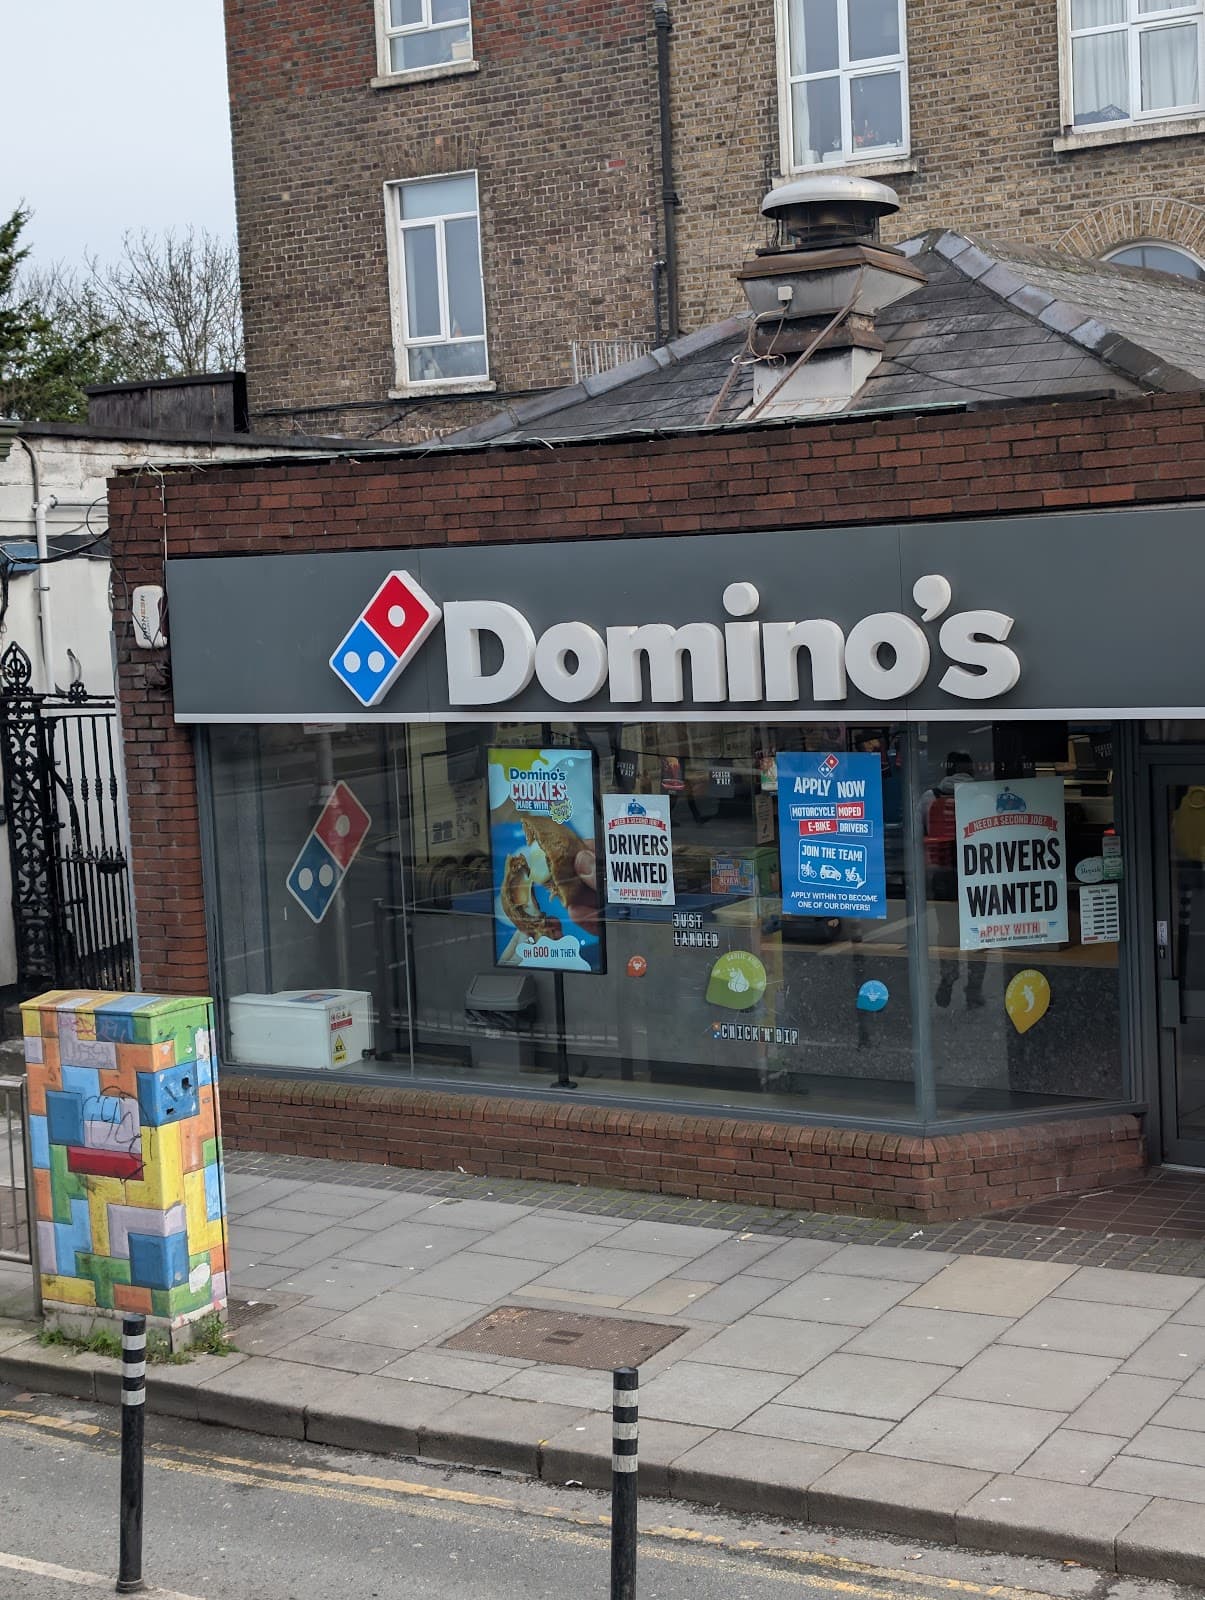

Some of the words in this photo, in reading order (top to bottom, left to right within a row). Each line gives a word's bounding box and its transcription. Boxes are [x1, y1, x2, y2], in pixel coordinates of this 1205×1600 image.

[443, 574, 1021, 706] Domino's
[510, 768, 566, 781] Domino's
[510, 781, 567, 800] COOKIES
[794, 776, 831, 797] APPLY
[837, 780, 866, 798] NOW
[791, 807, 836, 817] MOTORCYCLE
[838, 806, 862, 817] MOPED
[807, 821, 831, 832] E-BIKE
[839, 822, 869, 834] DRIVERS
[972, 819, 992, 830] NEED
[993, 818, 999, 826] A
[1000, 815, 1029, 825] SECOND
[608, 834, 669, 856] DRIVERS
[801, 844, 820, 858] JOIN
[820, 847, 837, 860] THE
[838, 848, 863, 862] TEAM!
[963, 837, 1061, 876] DRIVERS
[610, 861, 668, 884] WANTED
[619, 888, 639, 897] APPLY
[790, 891, 811, 899] APPLY
[812, 892, 837, 900] WITHIN
[849, 894, 878, 902] BECOME
[966, 880, 1058, 918] WANTED
[797, 900, 813, 908] ONE
[812, 901, 823, 909] OF
[823, 902, 840, 910] OUR
[840, 903, 871, 912] DRIVERS!
[673, 913, 703, 928] JUST
[1013, 921, 1047, 935] WITH
[674, 931, 720, 947] LANDED
[523, 948, 532, 958] OH
[533, 946, 549, 958] GOO
[550, 948, 559, 958] ON
[560, 948, 577, 958] THEN
